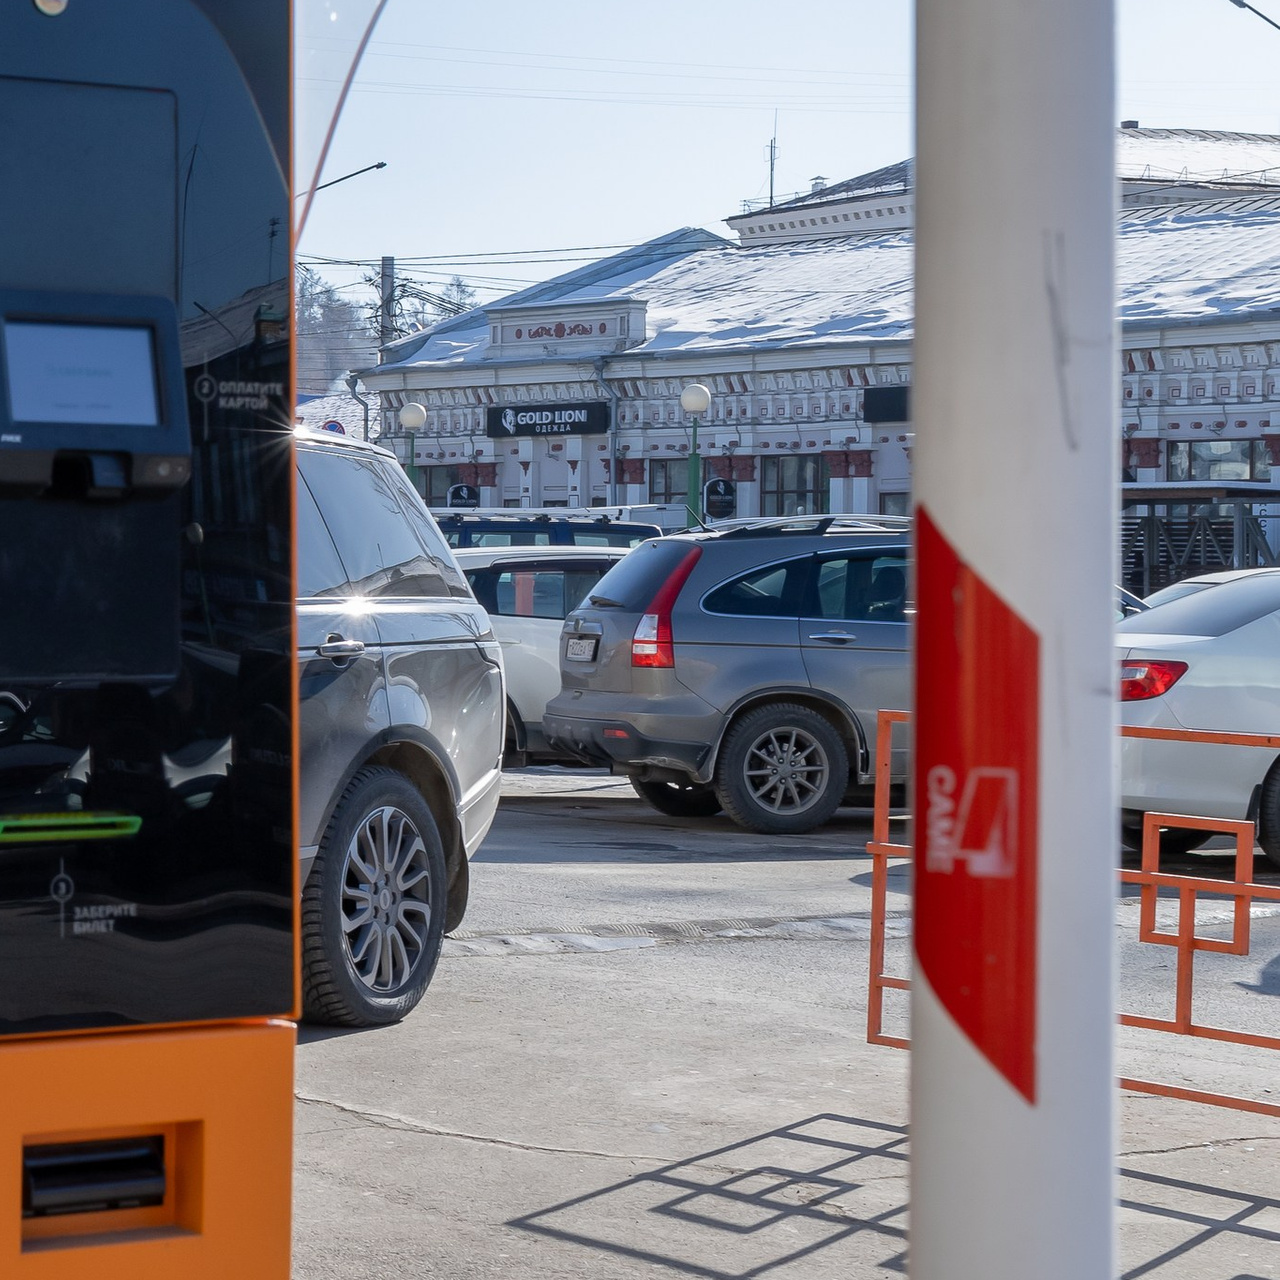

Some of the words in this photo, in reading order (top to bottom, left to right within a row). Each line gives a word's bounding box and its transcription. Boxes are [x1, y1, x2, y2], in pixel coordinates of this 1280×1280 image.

[218, 380, 283, 396] ОПЛАТИТЕ
[218, 395, 269, 410] КАРТОЙ
[516, 411, 553, 425] GOLD
[554, 409, 588, 423] LION
[535, 424, 571, 433] ОДЕЖДА
[925, 764, 957, 875] CAME
[73, 903, 138, 920] ЗАБЕРИТЕ
[73, 919, 115, 935] БИЛЕТ
